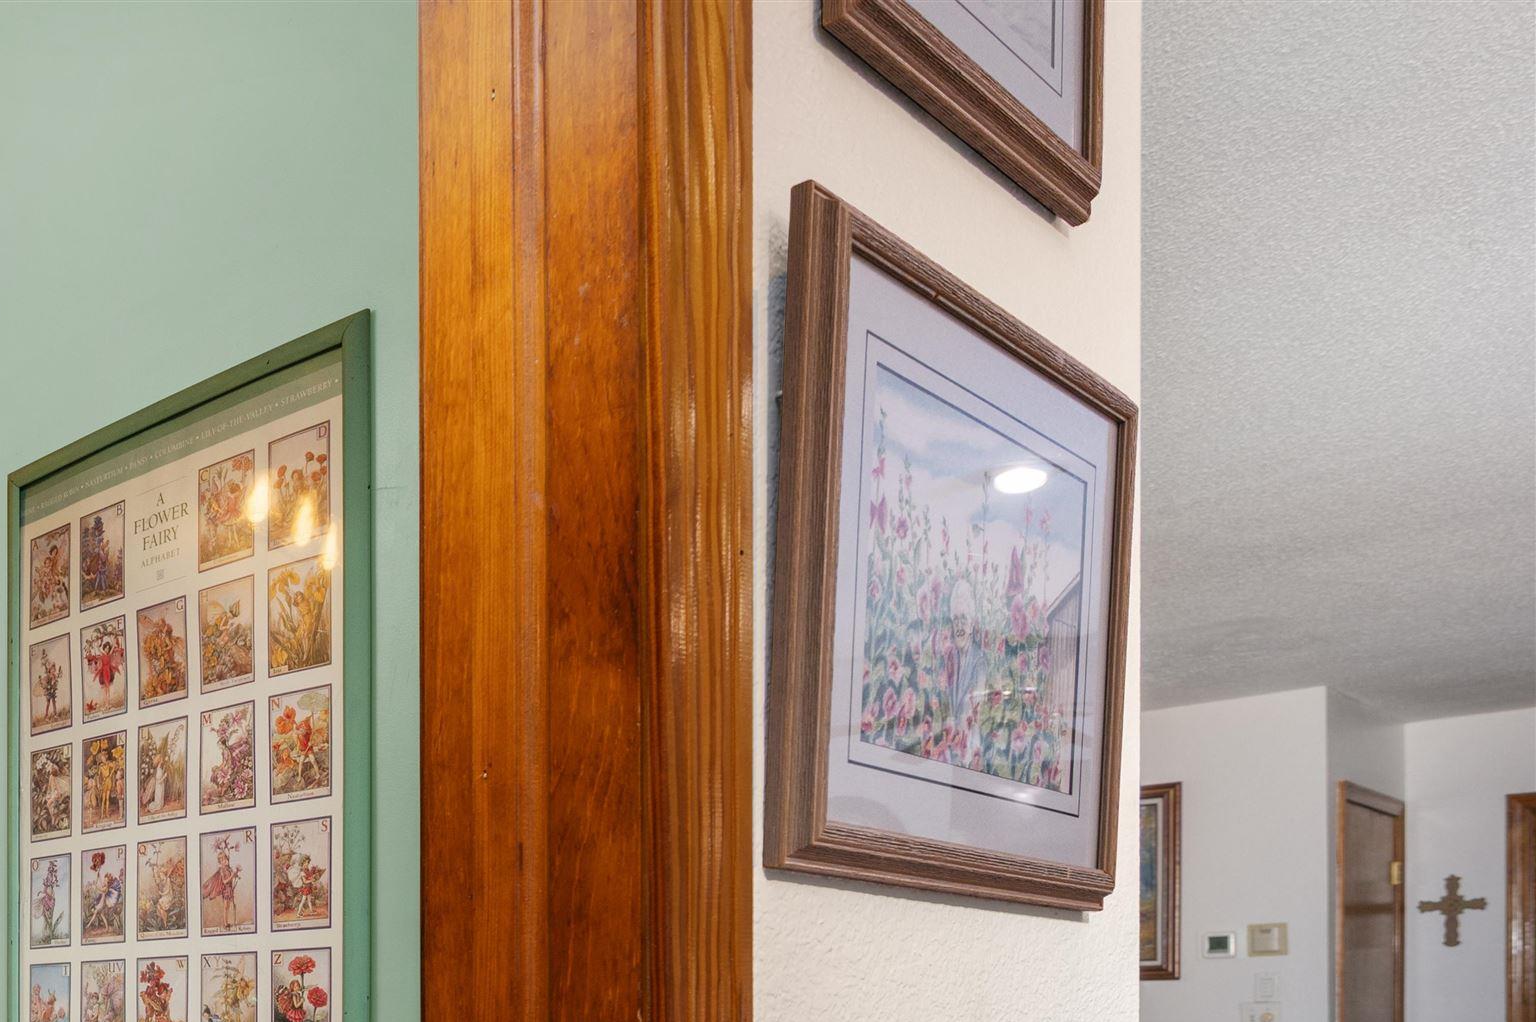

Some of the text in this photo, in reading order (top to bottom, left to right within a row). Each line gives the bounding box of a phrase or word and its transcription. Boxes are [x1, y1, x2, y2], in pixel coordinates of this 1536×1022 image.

[156, 492, 165, 507] A
[115, 505, 123, 516] B
[134, 502, 189, 535] FLOWER
[142, 524, 179, 551] FAIRY
[140, 547, 181, 569] ALPHABET
[271, 697, 281, 711] N
[202, 714, 212, 726] M
[320, 819, 328, 833] S
[245, 829, 253, 843] R
[138, 844, 147, 856] Q
[273, 953, 282, 965] Z
